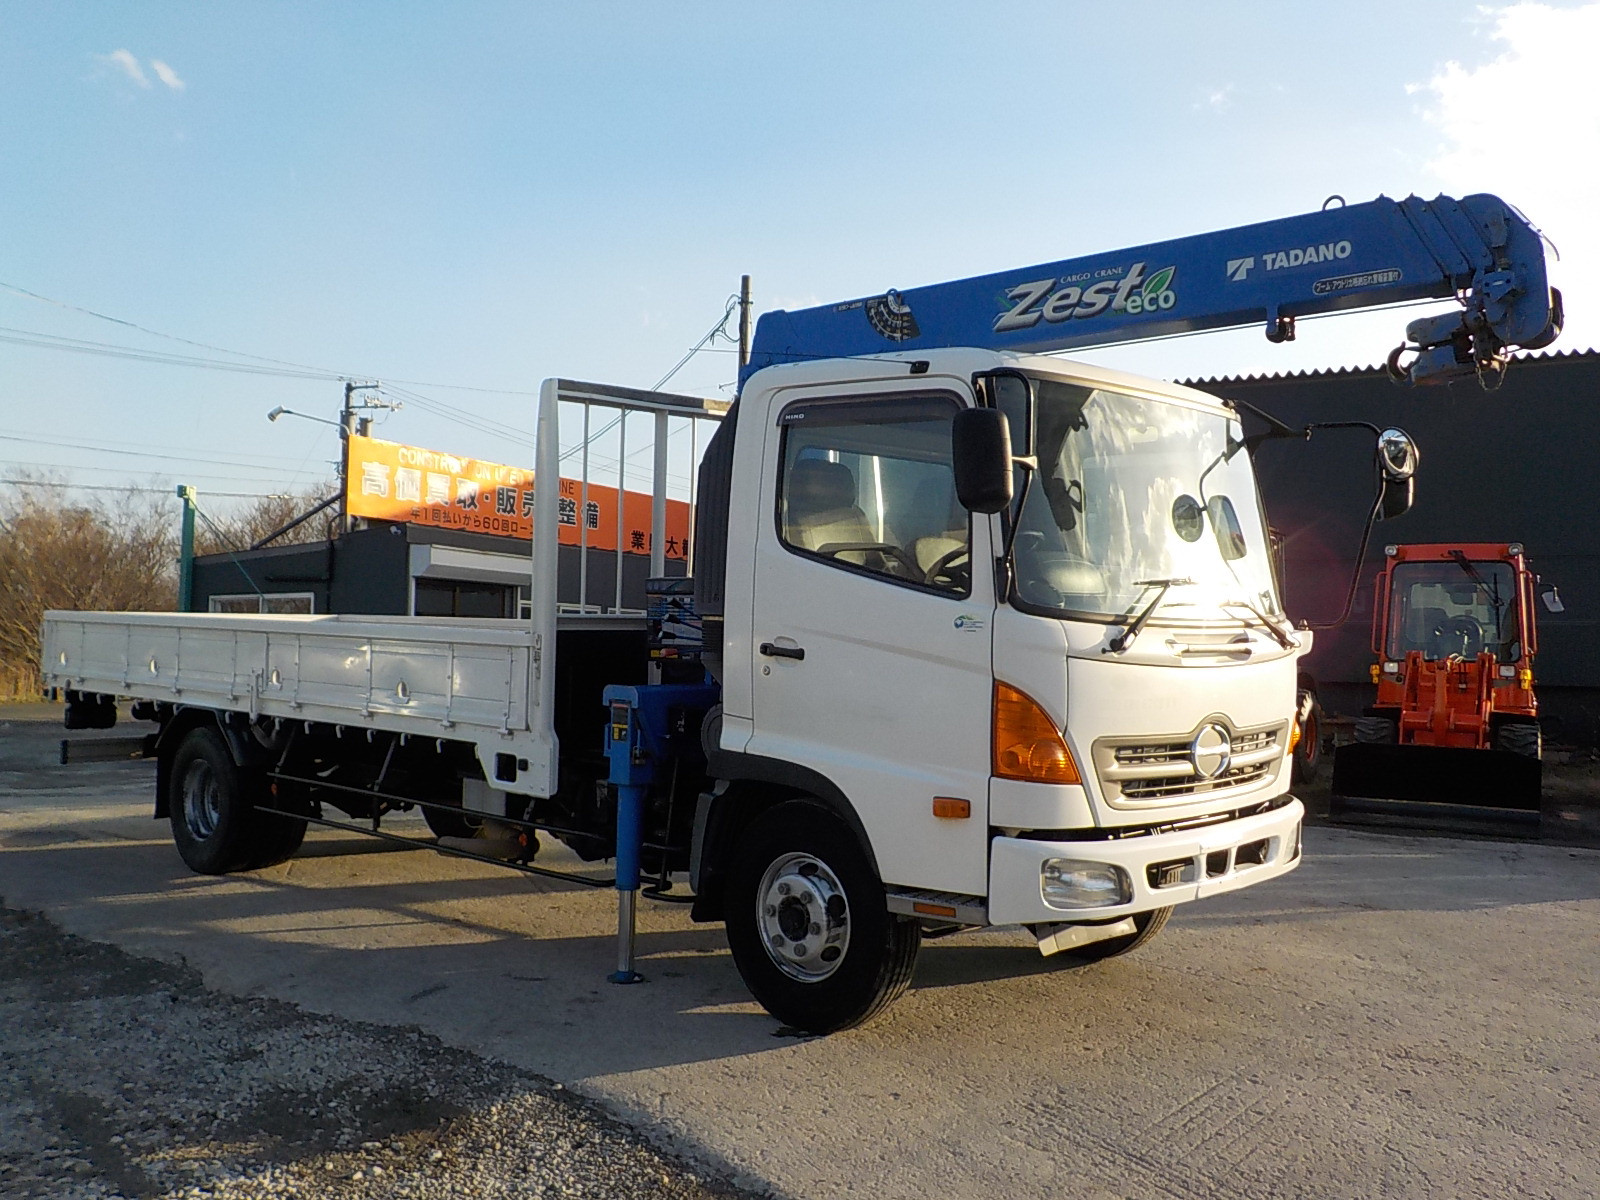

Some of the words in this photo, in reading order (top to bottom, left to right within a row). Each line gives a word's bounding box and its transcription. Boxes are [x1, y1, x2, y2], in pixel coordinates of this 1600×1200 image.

[1263, 240, 1352, 271] TADANO
[1060, 272, 1091, 285] CARGO
[1094, 265, 1123, 279] CRANE
[992, 261, 1146, 333] Zest
[1126, 289, 1176, 315] eco
